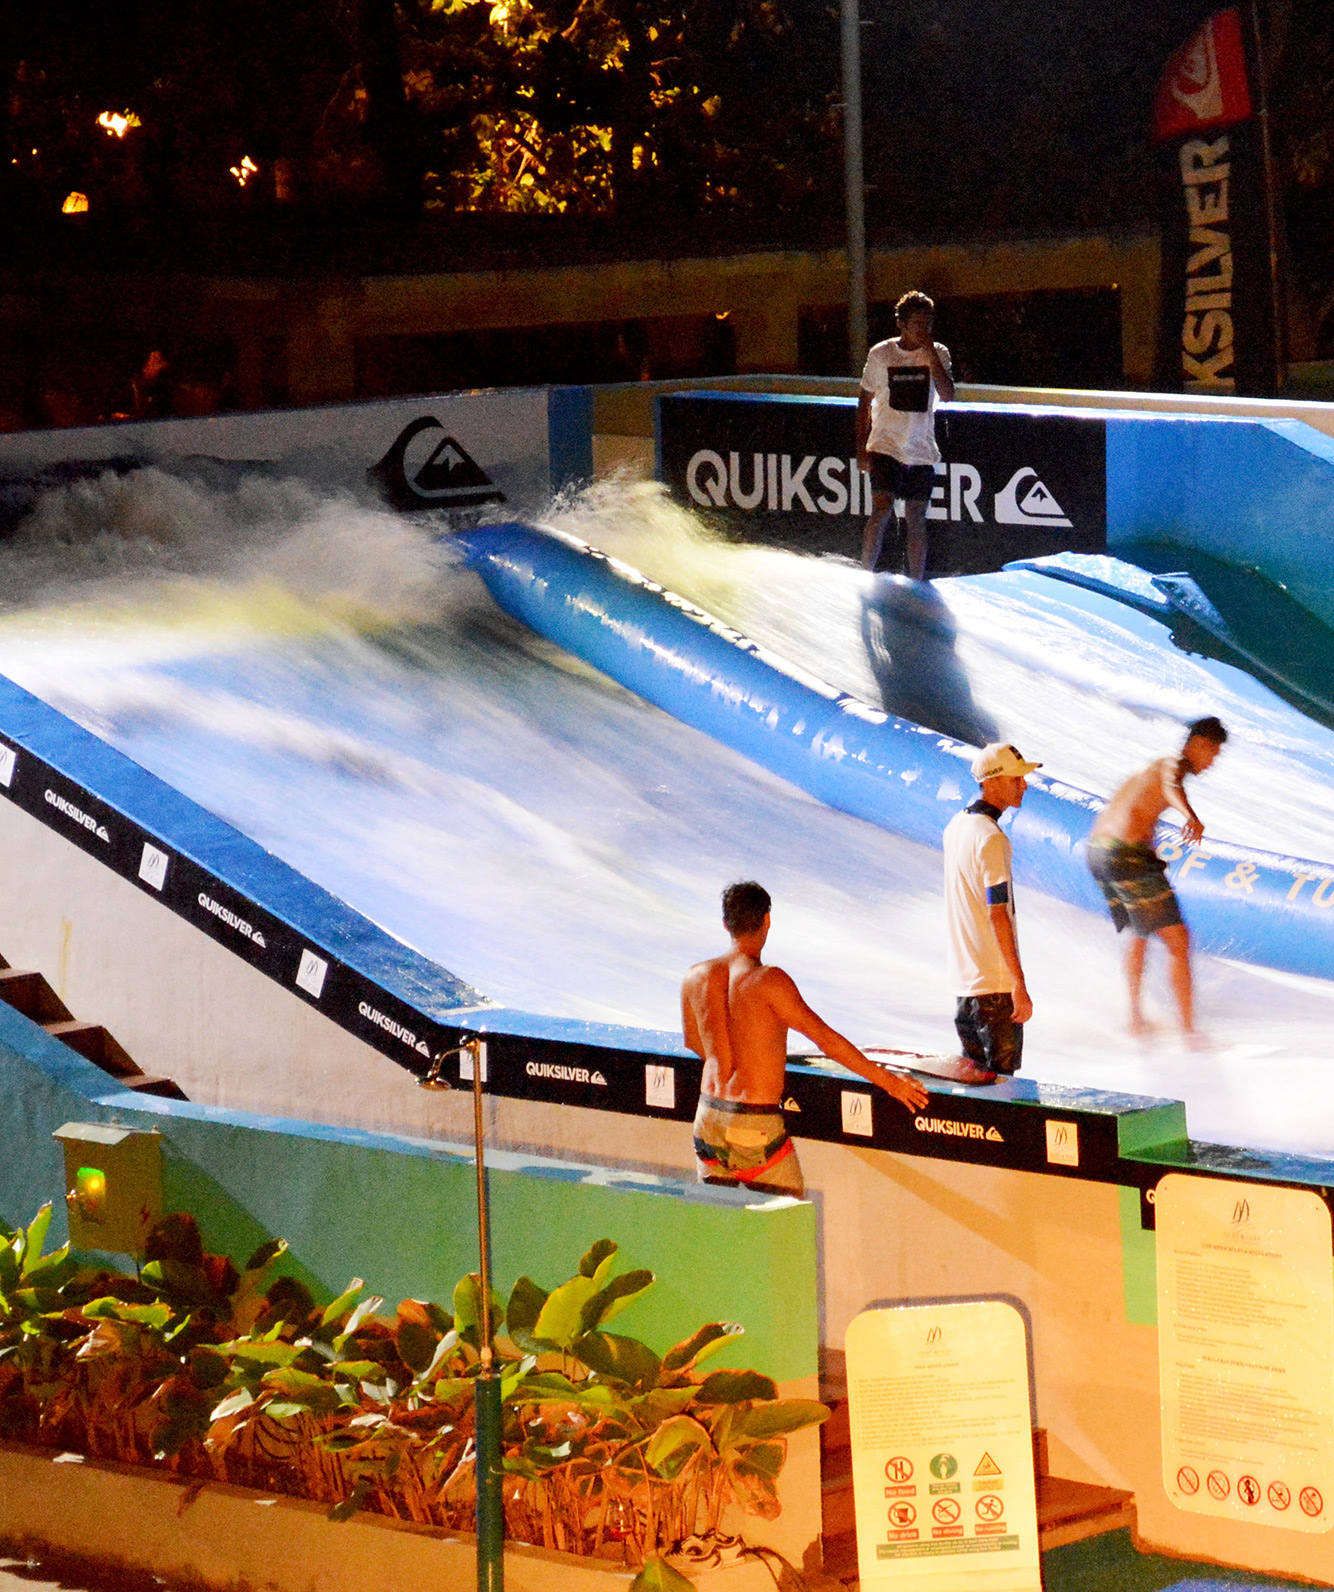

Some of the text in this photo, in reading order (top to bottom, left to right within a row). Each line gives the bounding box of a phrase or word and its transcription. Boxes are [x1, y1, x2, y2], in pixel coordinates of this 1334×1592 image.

[44, 789, 97, 834] QUIKSILVER
[1224, 862, 1261, 894] &
[197, 892, 253, 938] QUIKSILVER
[358, 1001, 417, 1048] QUIKSILVER
[526, 1061, 590, 1083] QUIKSILVER
[915, 1116, 985, 1140] QUIKSILVER
